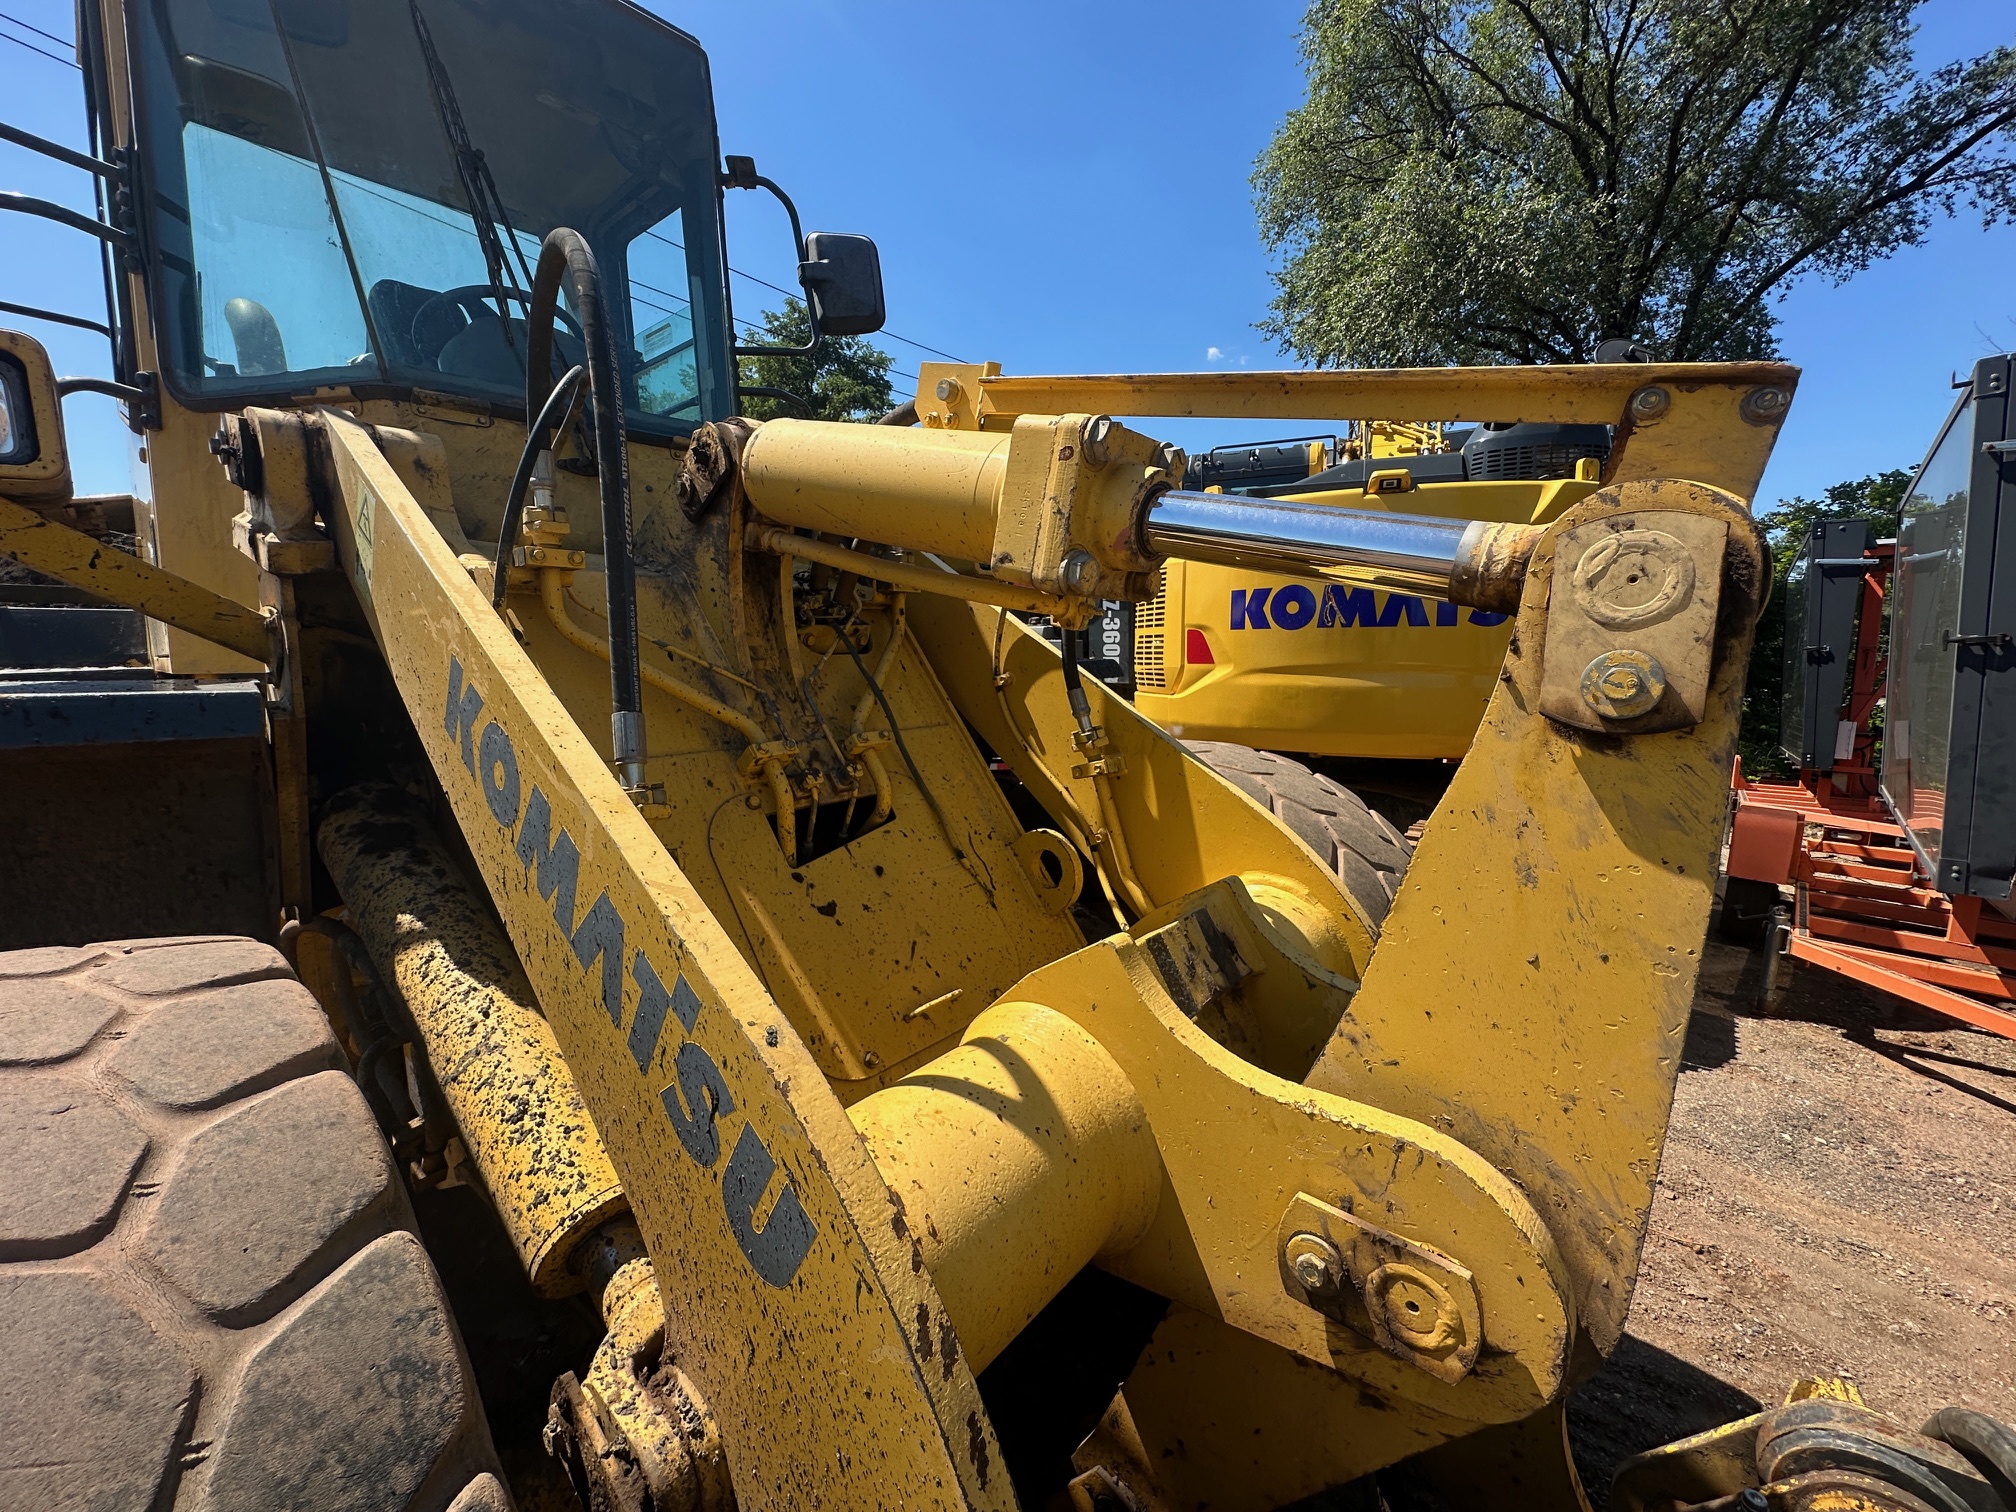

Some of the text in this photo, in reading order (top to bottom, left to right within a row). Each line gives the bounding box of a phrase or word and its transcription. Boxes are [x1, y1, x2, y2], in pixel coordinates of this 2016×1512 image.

[606, 327, 618, 370] SERVICE
[613, 371, 624, 424] EXTENDED
[1102, 598, 1121, 684] Z-360
[444, 653, 819, 1290] KOMATSU
